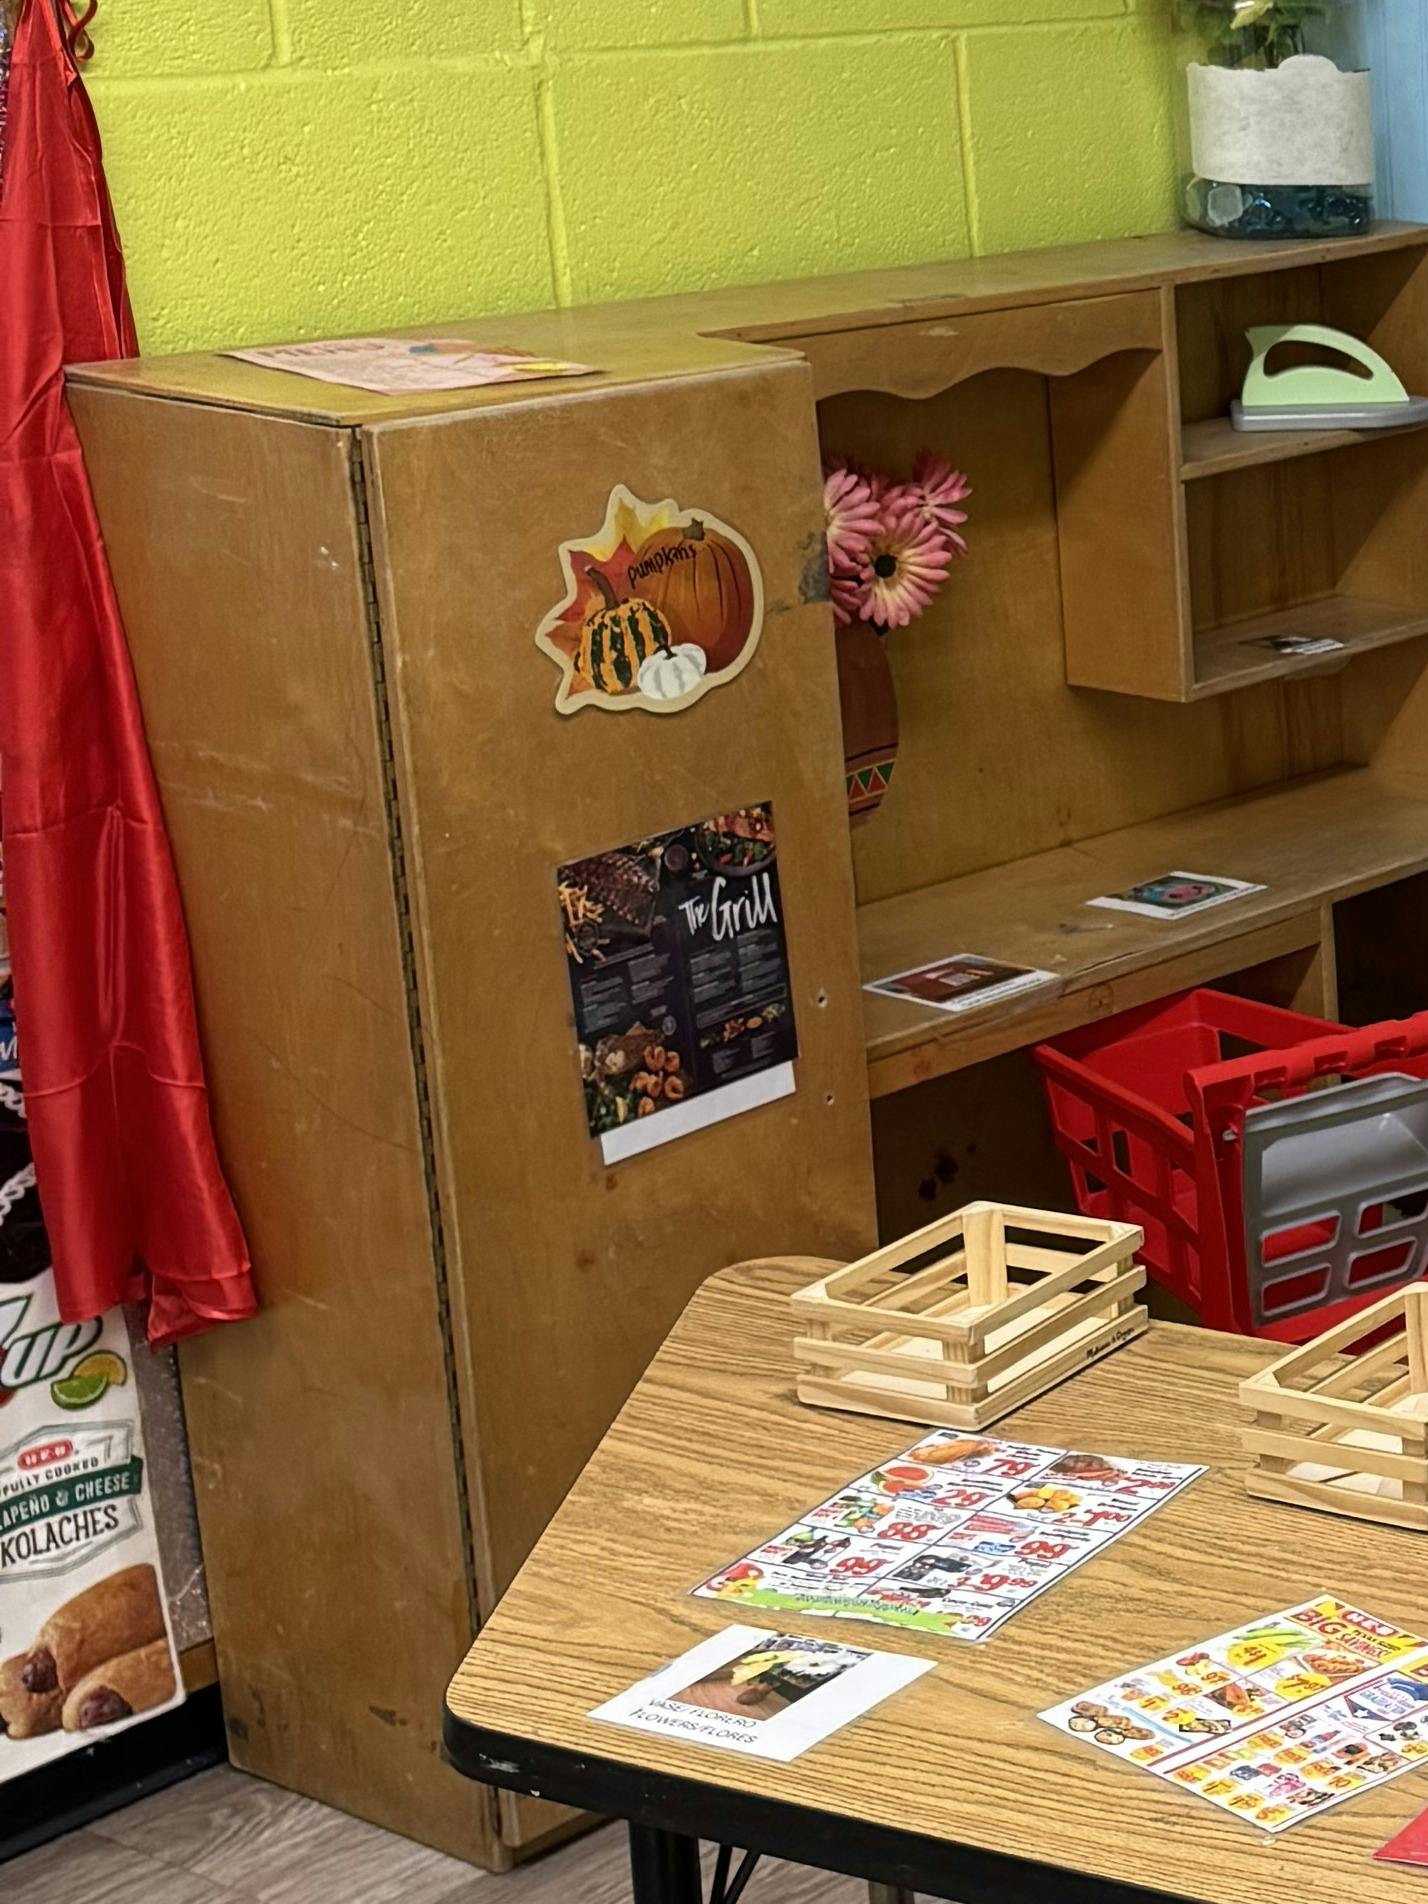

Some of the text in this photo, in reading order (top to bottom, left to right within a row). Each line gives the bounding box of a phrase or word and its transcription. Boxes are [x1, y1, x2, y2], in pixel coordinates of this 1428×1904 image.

[678, 872, 778, 941] The Grill
[3, 1456, 99, 1496] FULLY COOKED
[75, 1477, 130, 1498] CHEESE
[1, 1504, 119, 1569] KOLACHES
[1290, 1608, 1348, 1635] BIG
